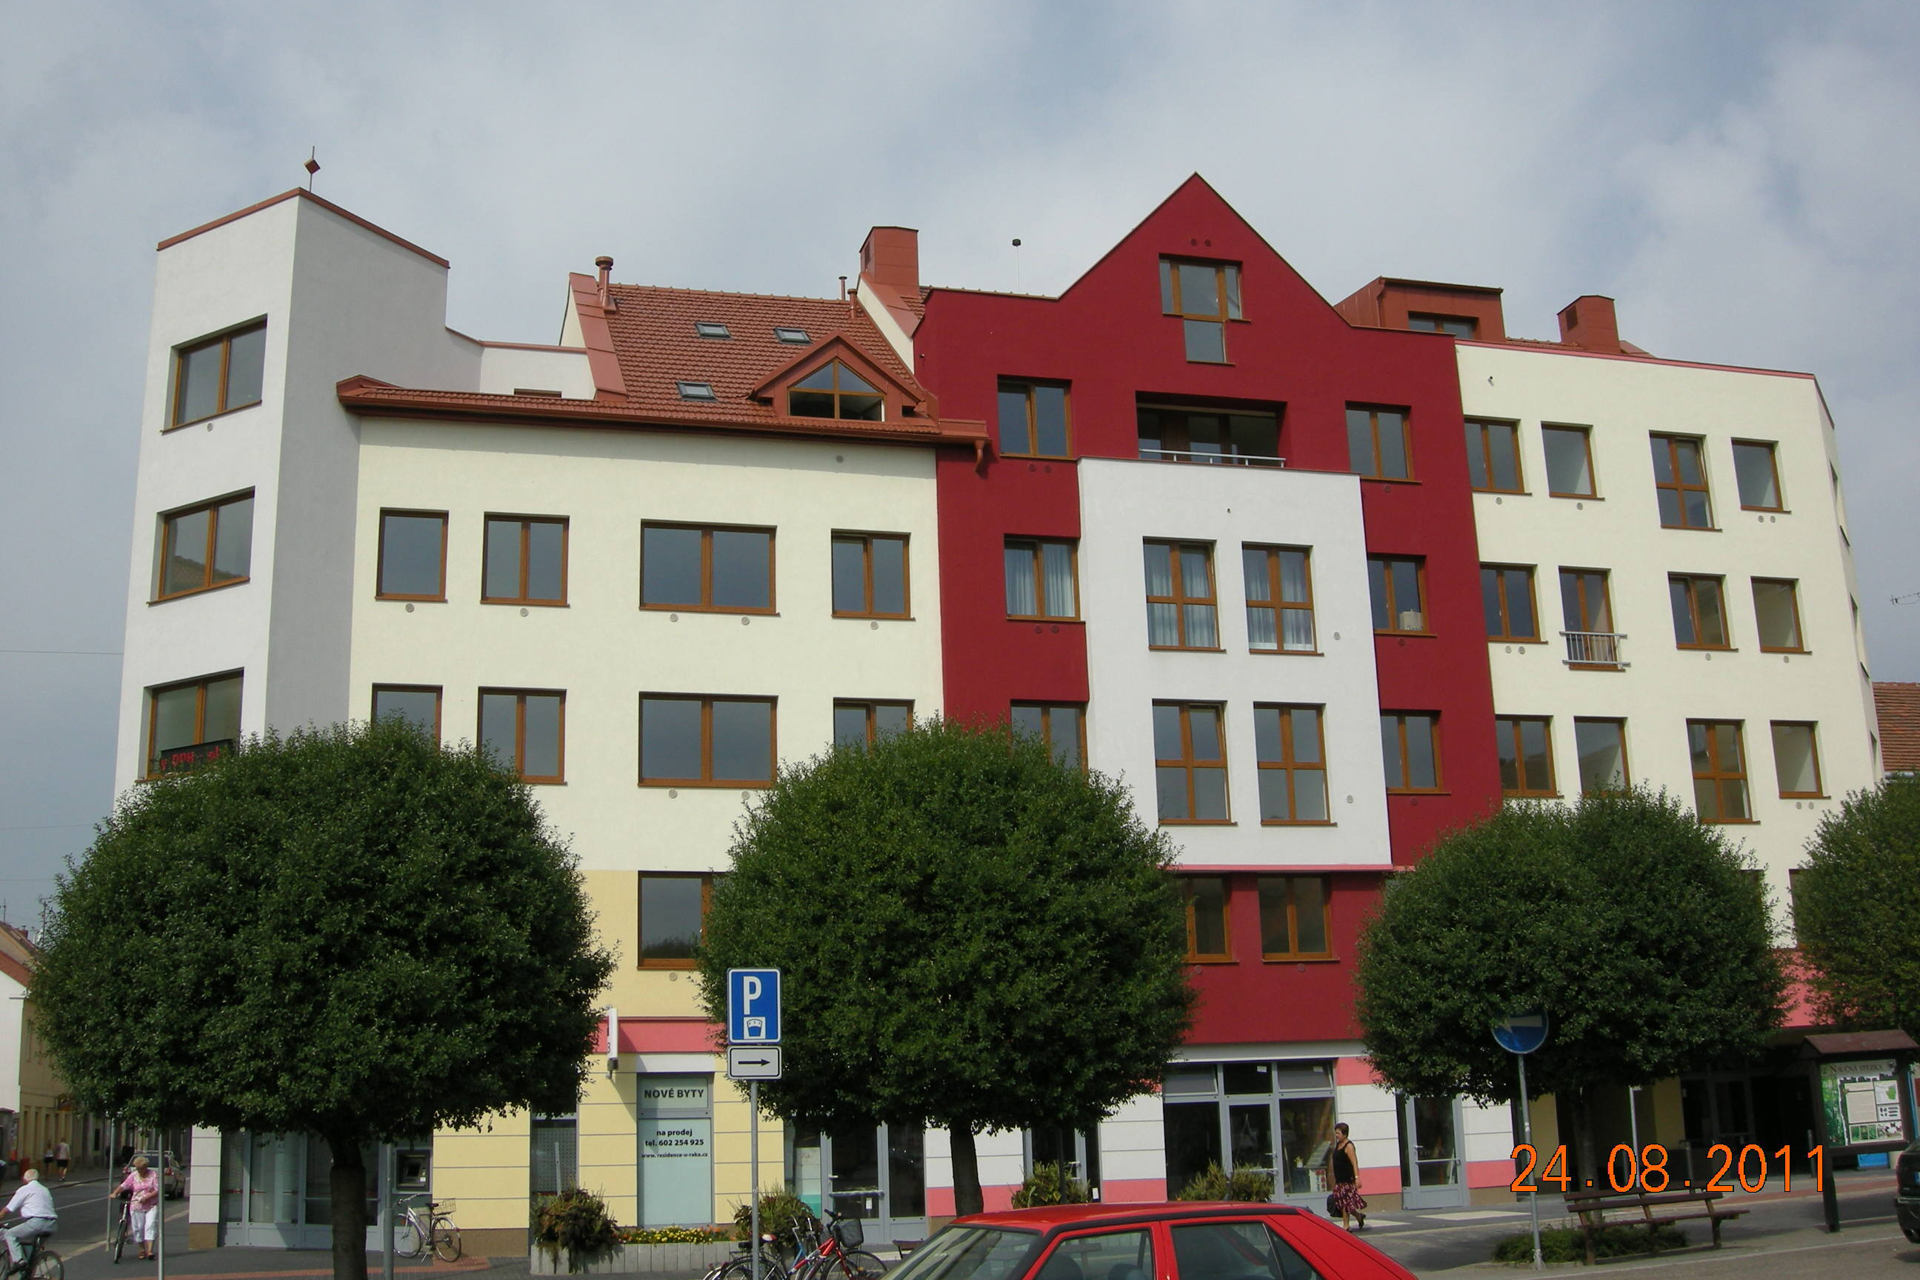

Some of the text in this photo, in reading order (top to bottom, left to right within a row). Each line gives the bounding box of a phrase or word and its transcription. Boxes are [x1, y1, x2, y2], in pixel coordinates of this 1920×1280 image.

[743, 976, 762, 1015] P
[644, 1088, 704, 1098] NOVÉ BYTY
[667, 1129, 692, 1137] prodej
